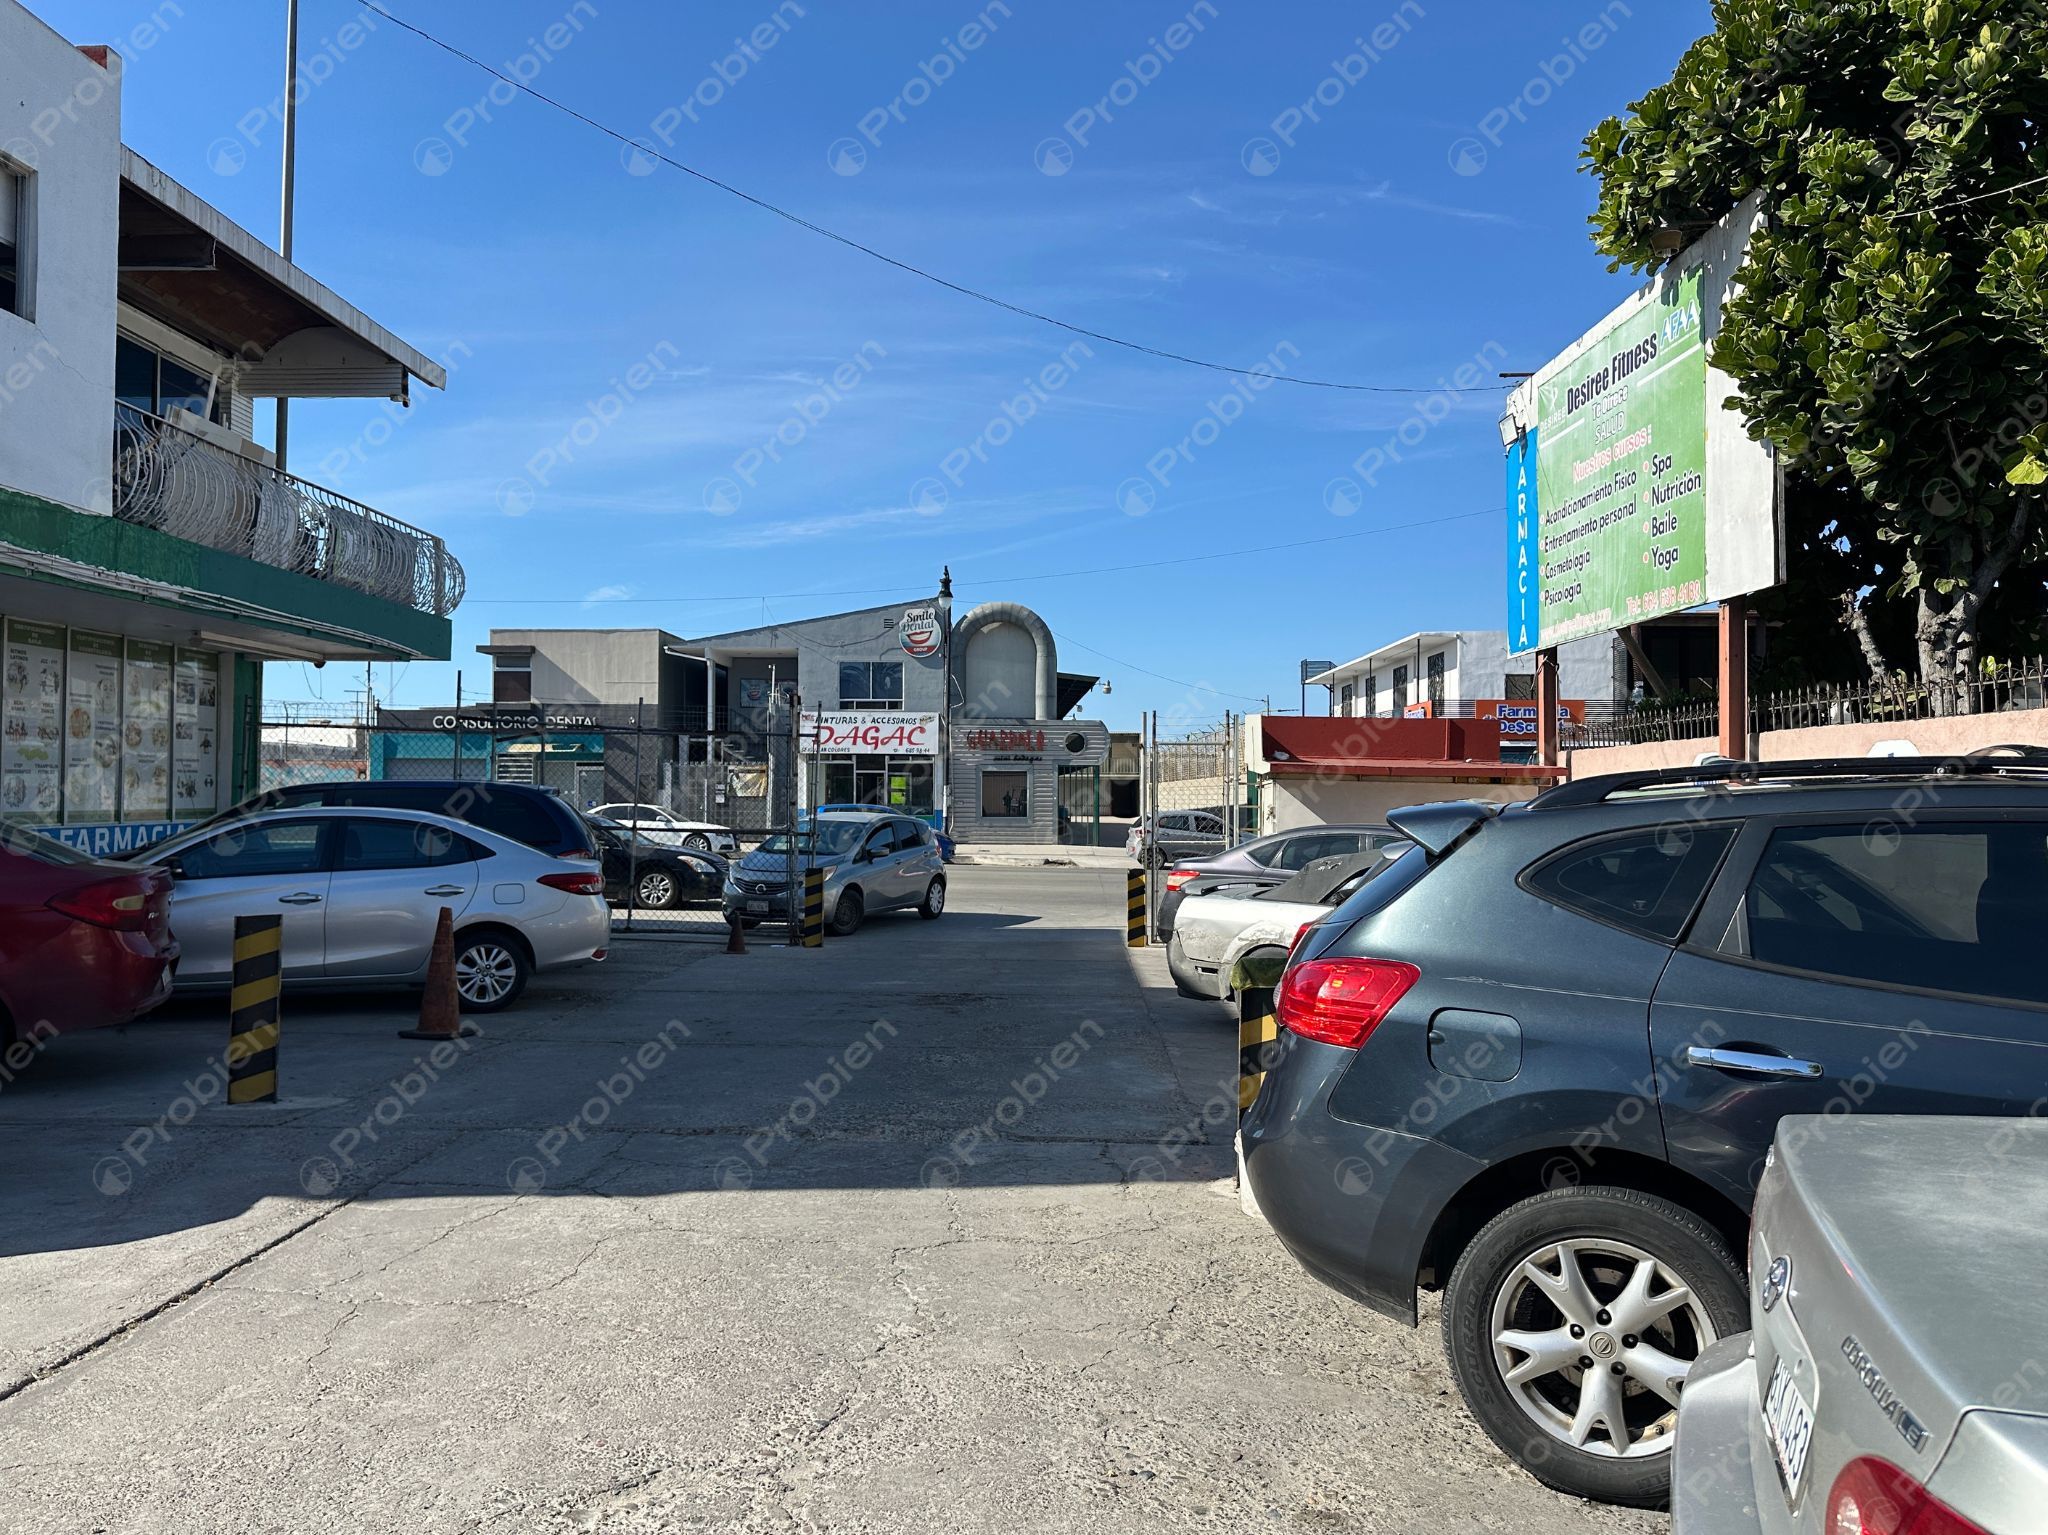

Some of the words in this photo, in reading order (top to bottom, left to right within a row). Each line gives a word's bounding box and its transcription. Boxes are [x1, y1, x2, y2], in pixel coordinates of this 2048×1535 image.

[1567, 366, 1609, 415] Desiree
[1612, 332, 1657, 385] Fitness
[1595, 411, 1625, 445] SALUD
[1573, 447, 1612, 483] Nuestros
[1652, 454, 1672, 479] Spa
[1652, 470, 1701, 507] Nutrición
[1545, 482, 1612, 527] Acondicionamiento
[1544, 517, 1597, 553] Entrenamiento
[1599, 493, 1637, 534] personal
[1652, 510, 1677, 538] Baile
[1545, 547, 1590, 580] Cosmetología
[1652, 546, 1679, 570] Yoga
[901, 620, 934, 632] Dental
[907, 611, 934, 623] Smile
[432, 715, 539, 729] CONSULTORIO
[871, 717, 917, 725] ACCESORIOS
[812, 726, 926, 750] DAGAC
[1463, 1282, 1496, 1405] SCORPION
